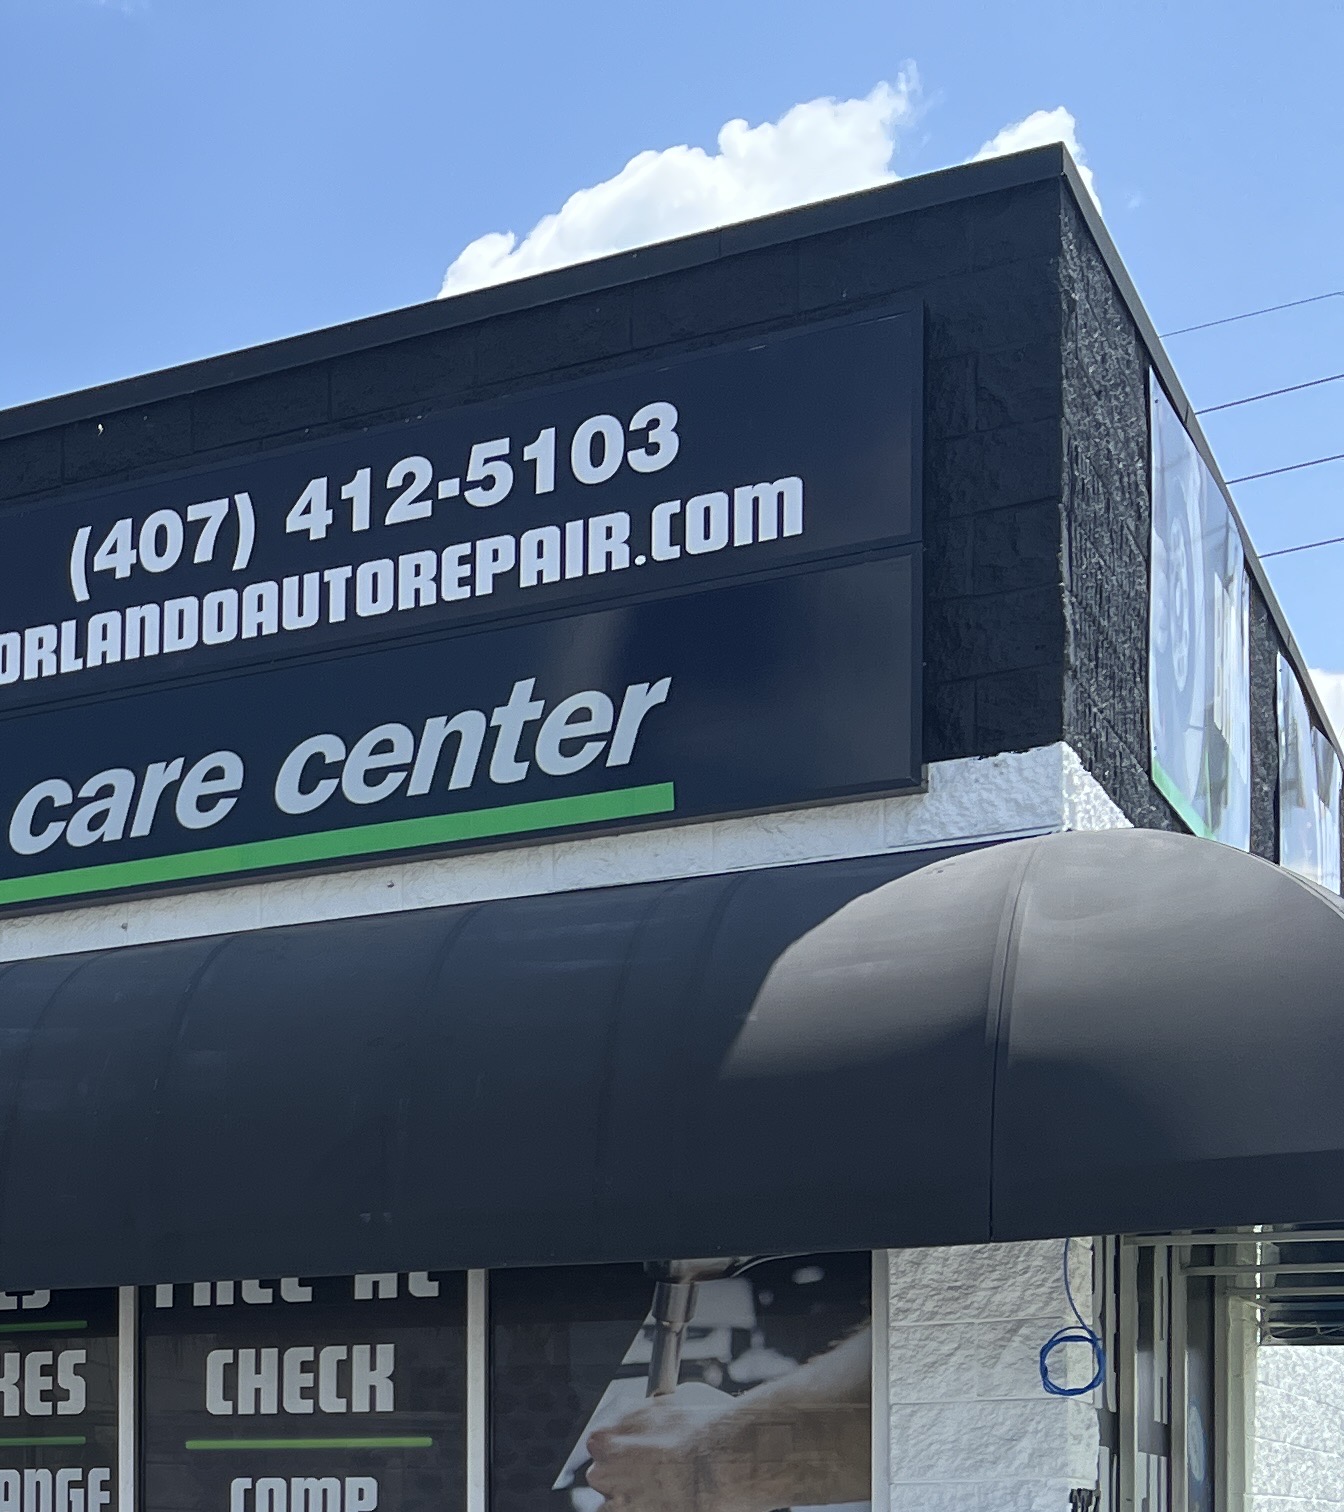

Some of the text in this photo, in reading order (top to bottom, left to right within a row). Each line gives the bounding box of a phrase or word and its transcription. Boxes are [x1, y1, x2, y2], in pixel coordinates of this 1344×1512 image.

[70, 400, 681, 601] (407) 412-5103
[6, 747, 244, 857] care
[272, 674, 670, 817] center
[205, 1344, 396, 1415] CHECK
